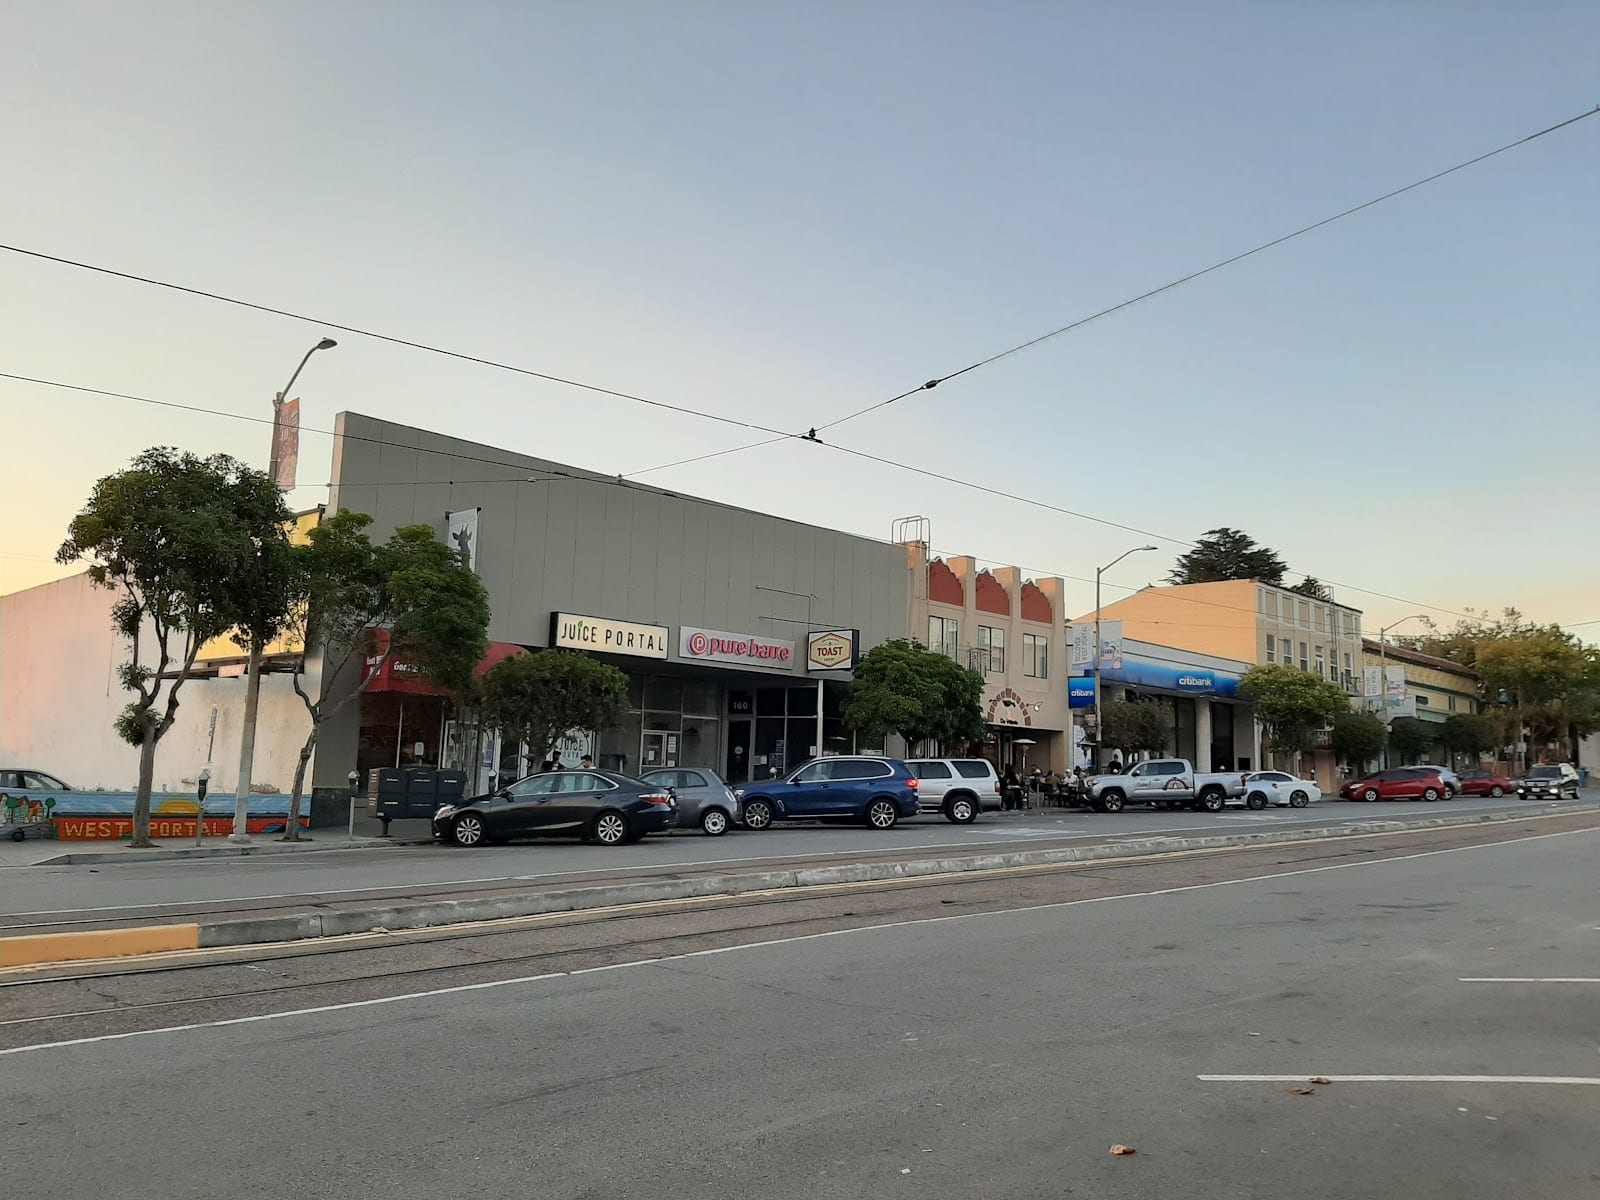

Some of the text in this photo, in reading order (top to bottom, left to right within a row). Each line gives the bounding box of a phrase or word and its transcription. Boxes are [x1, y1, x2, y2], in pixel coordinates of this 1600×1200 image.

[562, 621, 664, 651] JUICE PORTAL
[709, 637, 747, 656] pure
[749, 639, 790, 662] barre
[817, 646, 843, 656] TOAST
[1178, 675, 1212, 686] citibank
[1071, 689, 1094, 697] citibank
[733, 702, 748, 710] 160
[65, 821, 222, 837] WEST PORTAL
